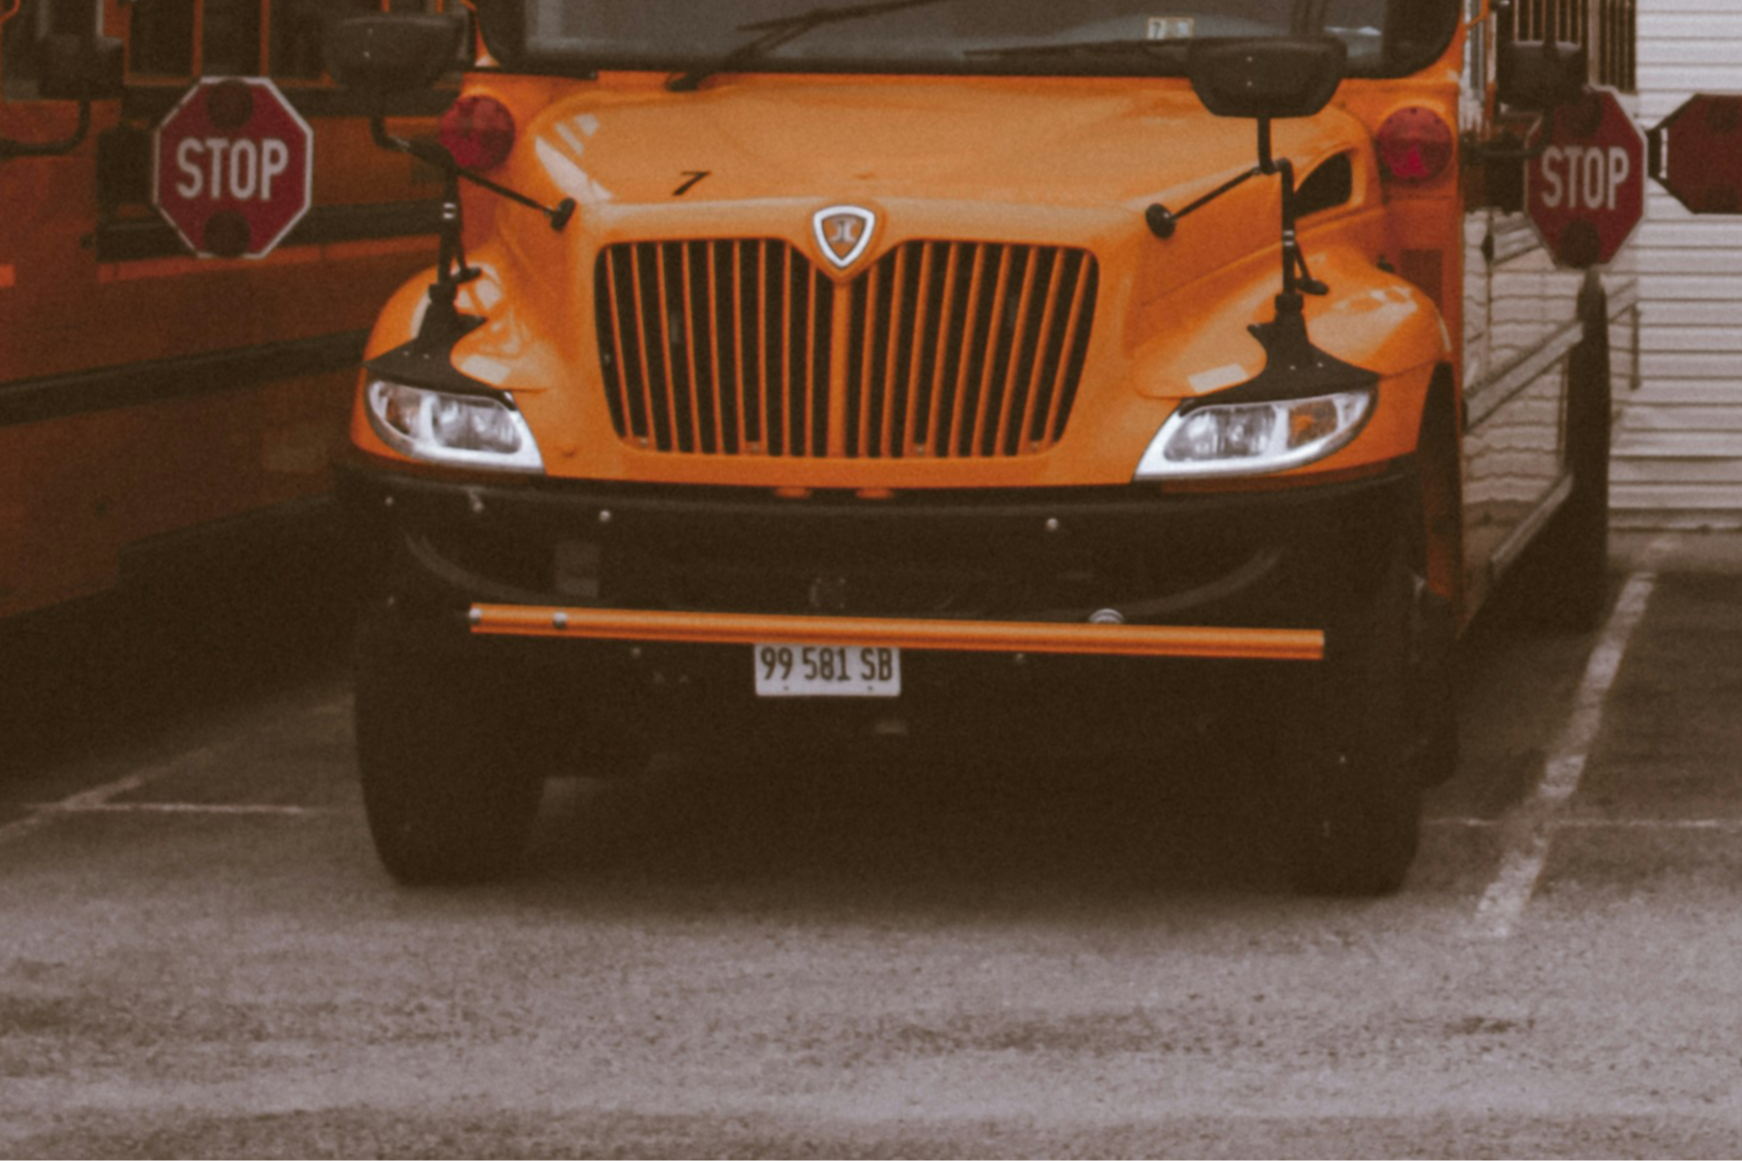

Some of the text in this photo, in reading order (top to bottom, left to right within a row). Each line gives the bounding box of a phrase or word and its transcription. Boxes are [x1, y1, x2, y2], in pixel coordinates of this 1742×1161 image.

[176, 138, 288, 201] STOP
[672, 170, 712, 196] 7
[1541, 145, 1630, 211] STOP
[760, 646, 892, 682] 99 581 SB
